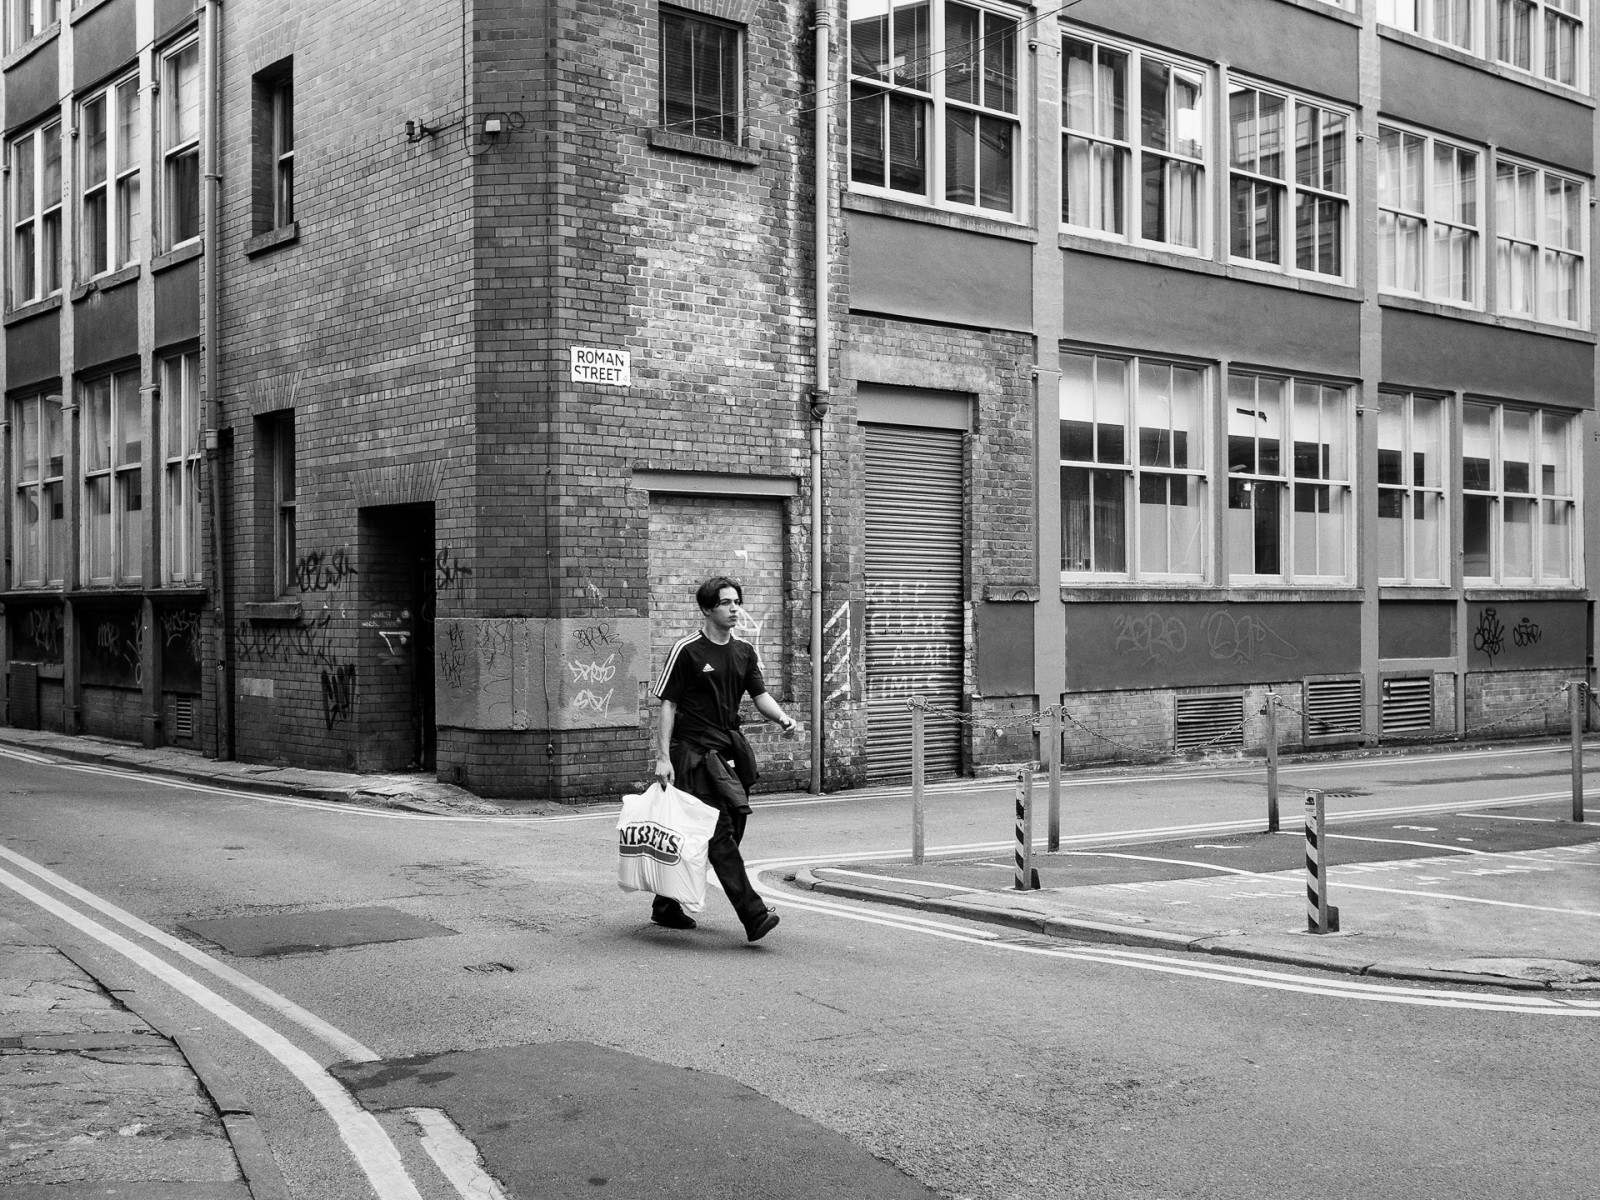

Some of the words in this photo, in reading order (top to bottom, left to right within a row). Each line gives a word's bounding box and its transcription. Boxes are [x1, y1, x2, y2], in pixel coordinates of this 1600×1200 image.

[577, 350, 624, 366] ROMAN
[574, 365, 622, 381] STREET
[865, 580, 929, 605] KEEP
[870, 611, 947, 636] CLEAR
[892, 643, 918, 668] AT
[922, 643, 951, 669] ALL
[867, 673, 943, 698] TIMES
